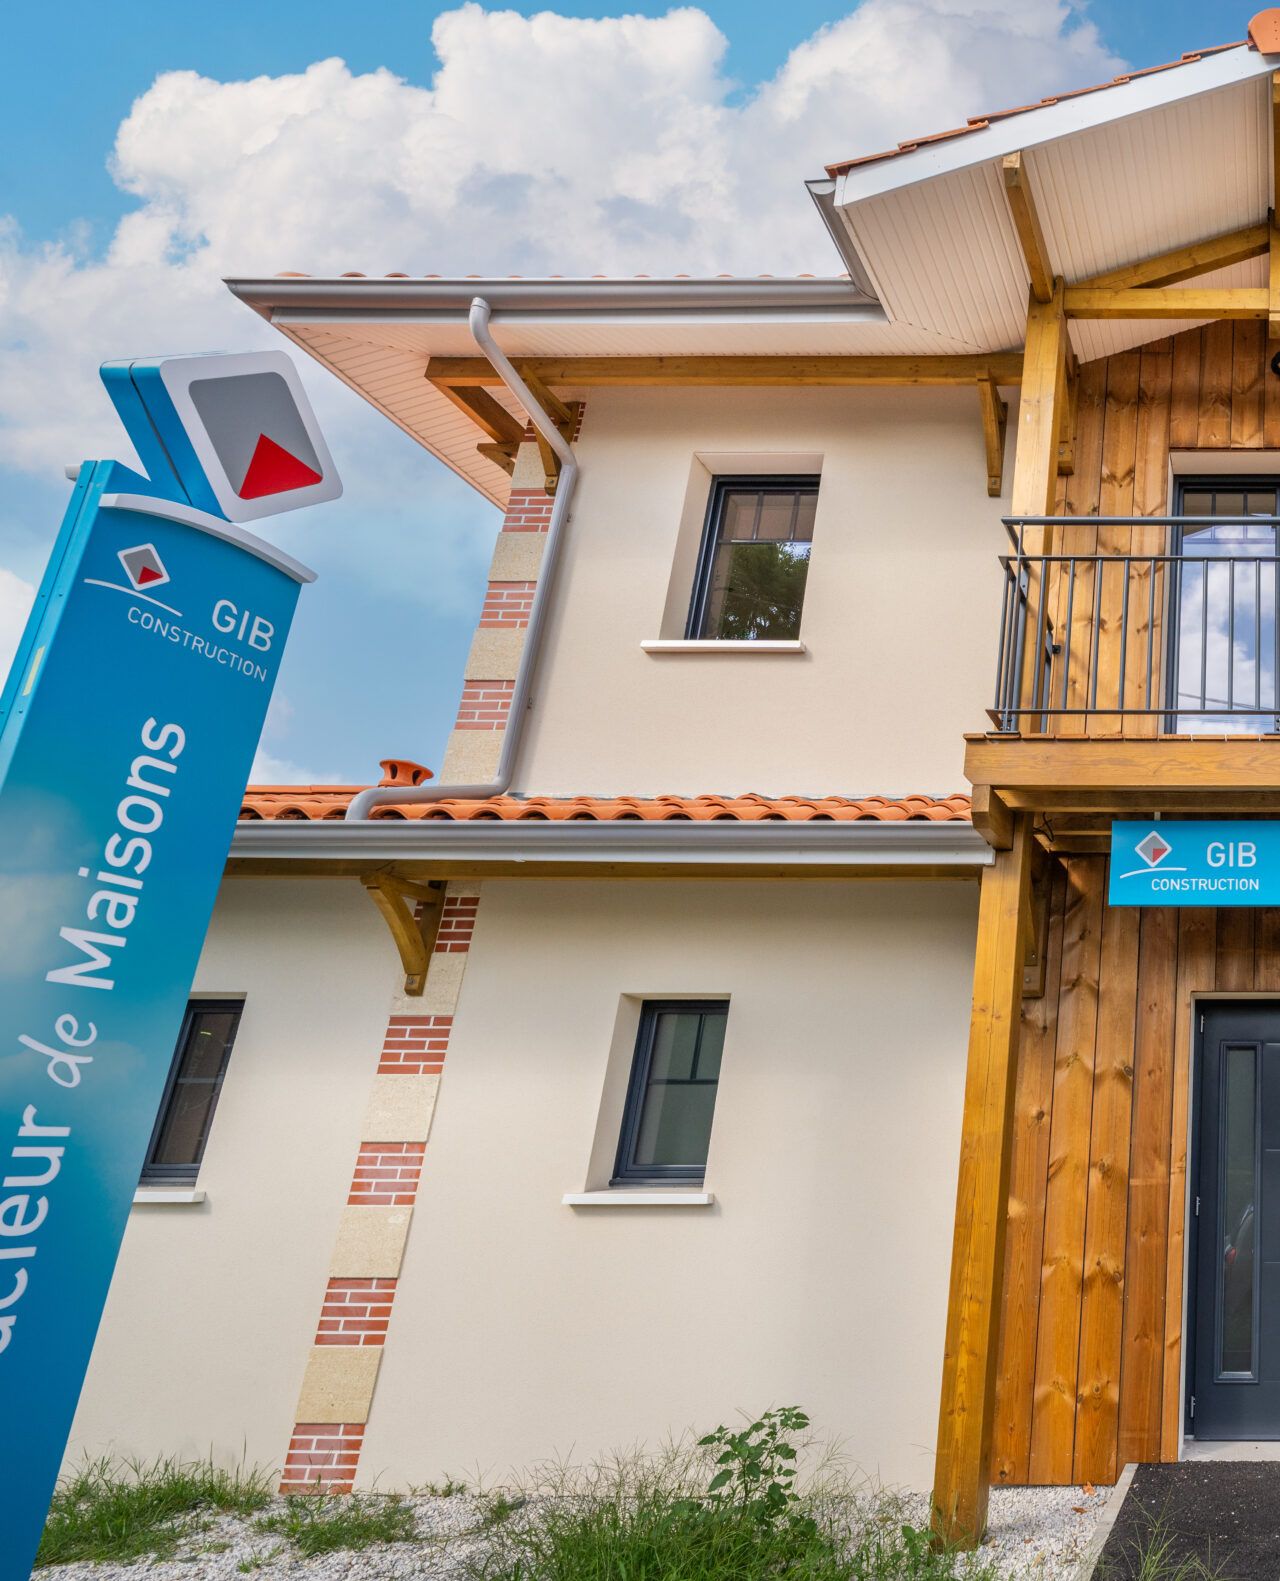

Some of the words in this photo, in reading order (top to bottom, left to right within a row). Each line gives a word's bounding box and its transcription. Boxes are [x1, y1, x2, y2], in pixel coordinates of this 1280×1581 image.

[127, 607, 267, 682] CONSTRUCTION
[212, 599, 275, 652] GIB
[46, 717, 186, 990] Maisons
[1151, 878, 1259, 891] CONSTRUCTION
[1206, 841, 1257, 867] GIB
[18, 1013, 97, 1088] de
